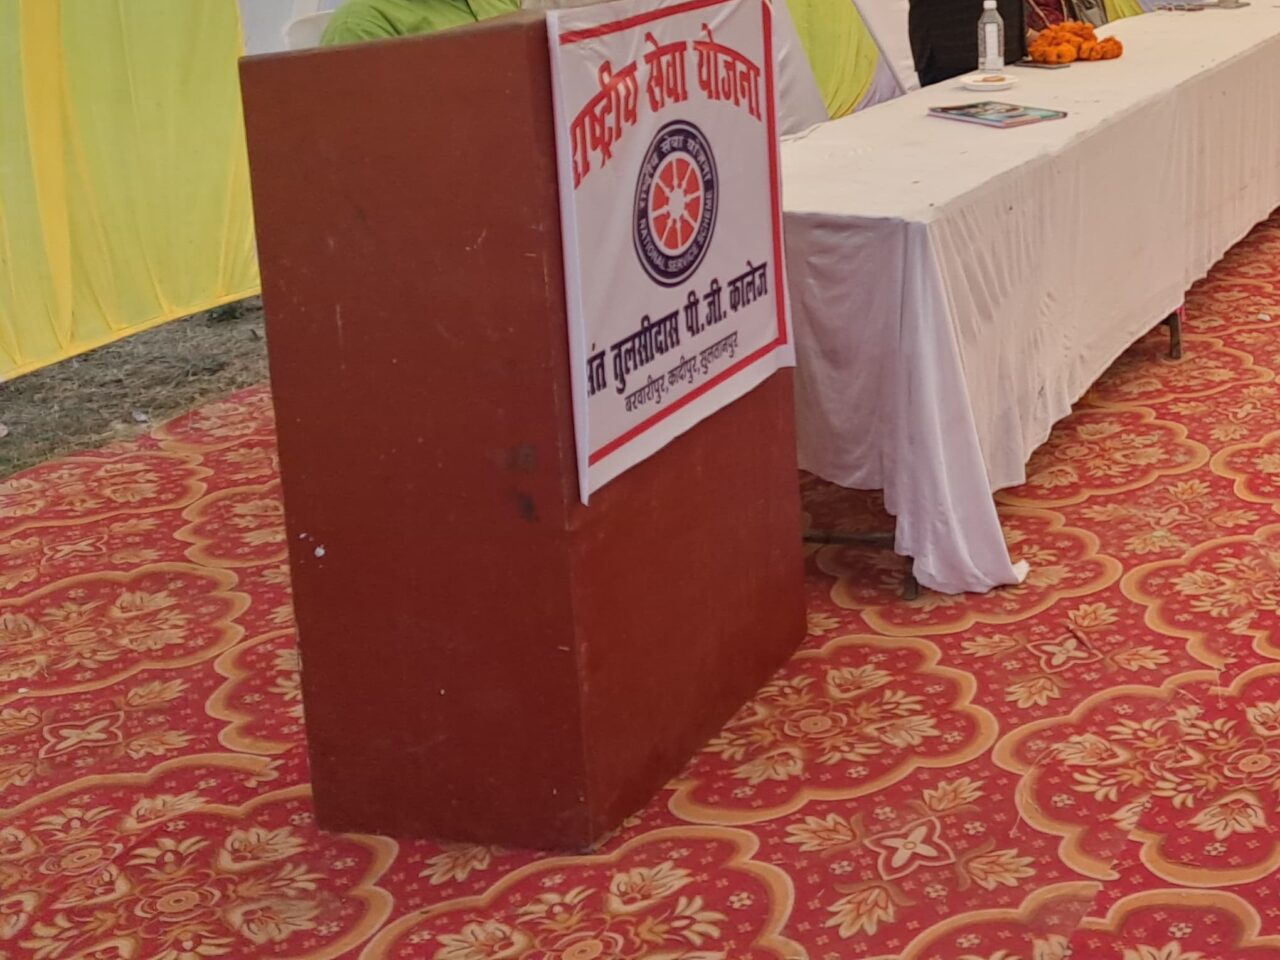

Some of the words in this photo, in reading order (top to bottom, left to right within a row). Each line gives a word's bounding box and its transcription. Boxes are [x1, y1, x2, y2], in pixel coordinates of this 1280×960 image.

[643, 31, 688, 113] सेवा
[693, 22, 762, 123] योजना
[639, 218, 666, 271] NATIONAL
[610, 314, 681, 394] तुलसीदास
[727, 260, 768, 312] कालेज
